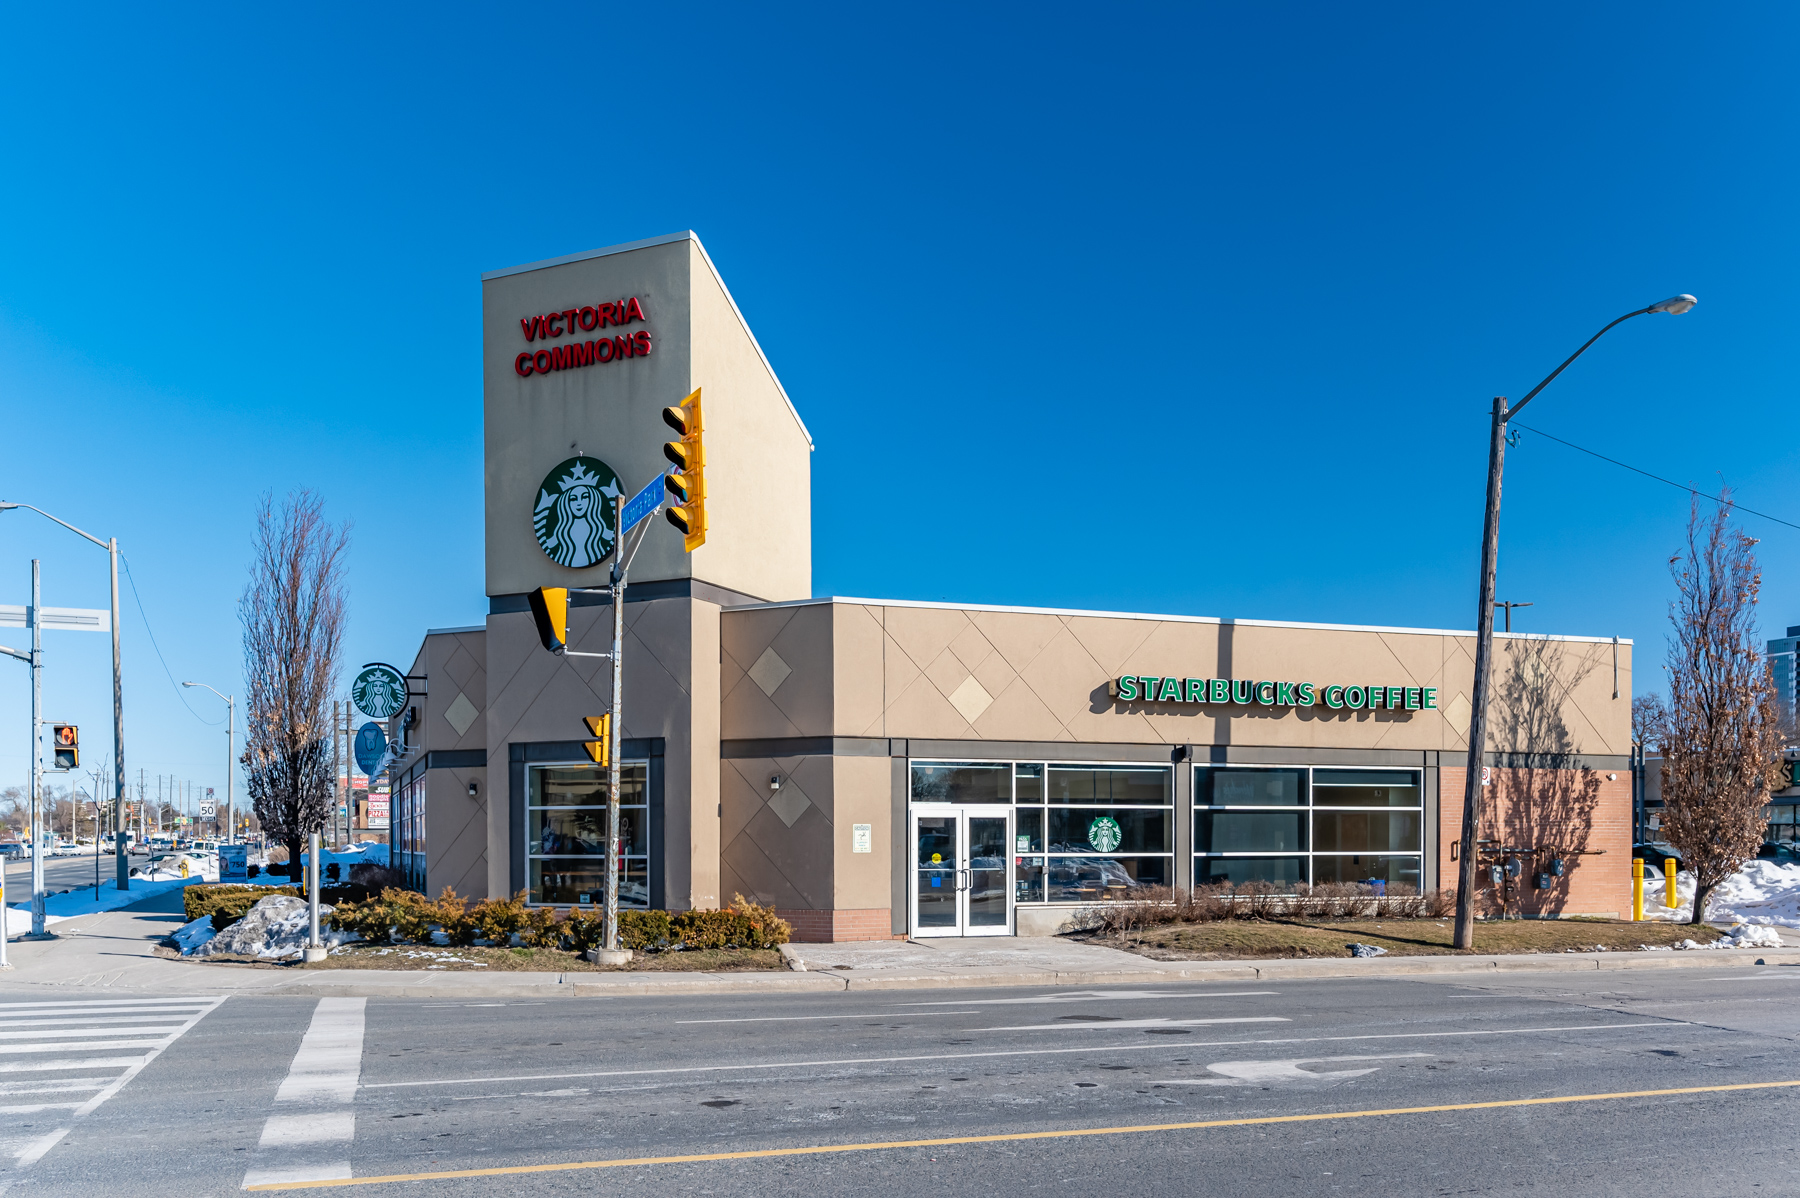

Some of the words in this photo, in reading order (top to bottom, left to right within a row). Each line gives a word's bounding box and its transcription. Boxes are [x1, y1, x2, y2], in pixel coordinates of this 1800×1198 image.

[520, 297, 645, 342] VICTORIA
[515, 331, 652, 377] COMMONS
[1118, 675, 1316, 706] STARBUCKS
[1325, 684, 1438, 710] COFFEE
[201, 806, 214, 815] 50
[368, 810, 383, 818] PIZZA
